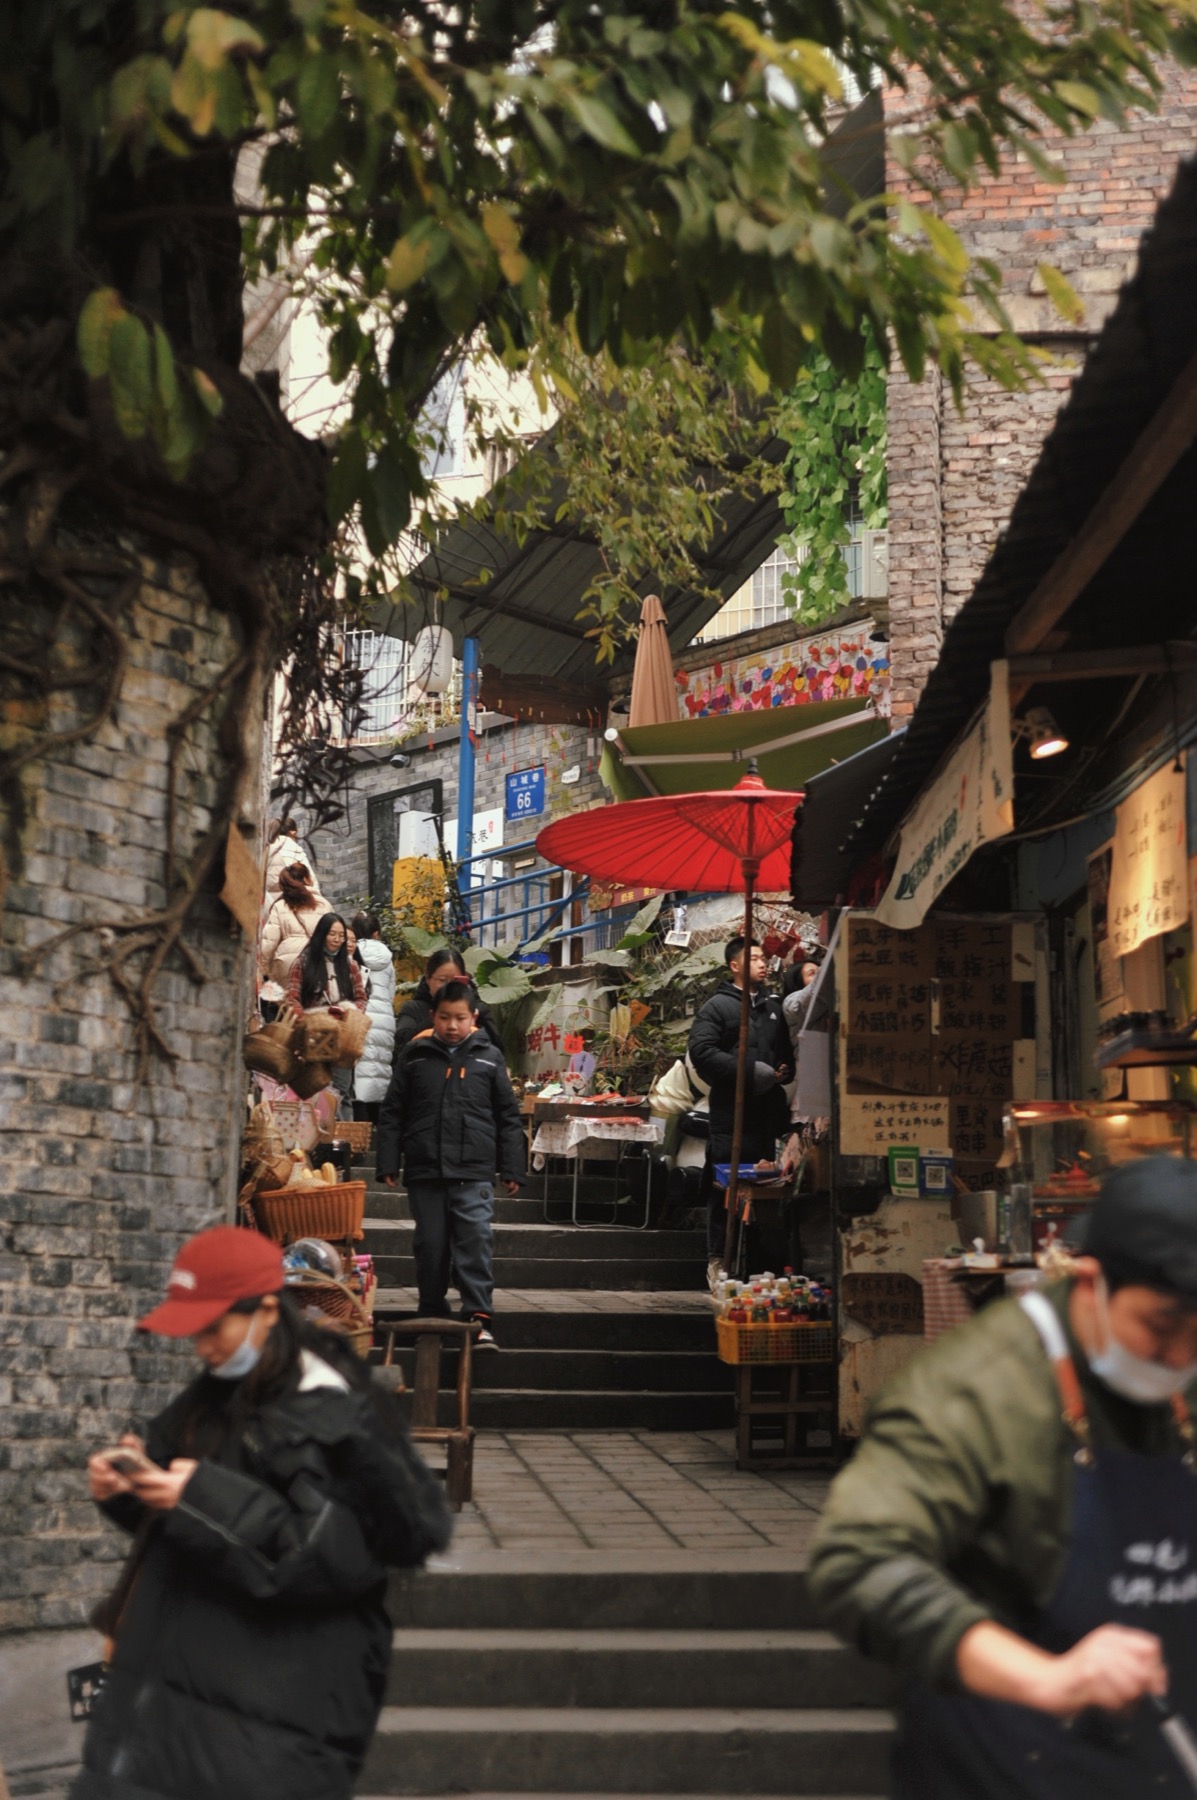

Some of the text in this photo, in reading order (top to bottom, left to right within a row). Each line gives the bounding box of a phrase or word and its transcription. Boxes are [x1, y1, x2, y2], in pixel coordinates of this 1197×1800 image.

[510, 772, 540, 788] 山城巷
[516, 791, 532, 810] 66
